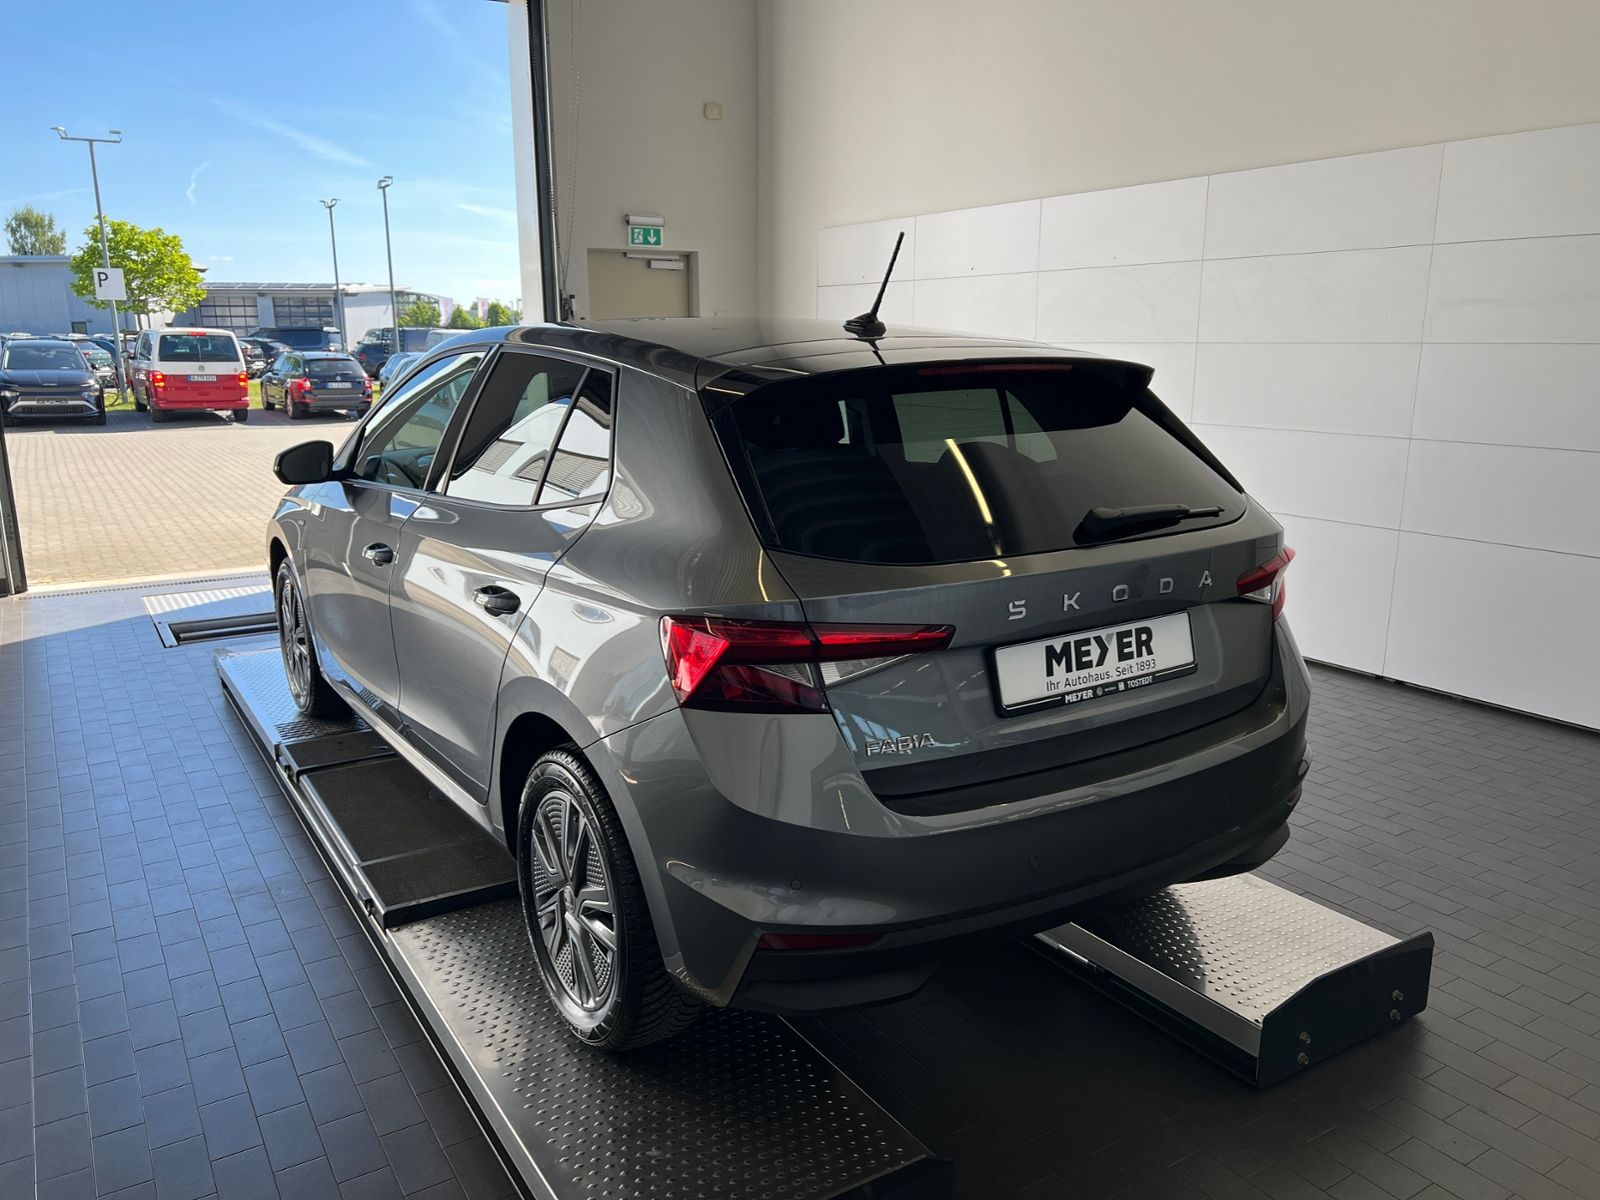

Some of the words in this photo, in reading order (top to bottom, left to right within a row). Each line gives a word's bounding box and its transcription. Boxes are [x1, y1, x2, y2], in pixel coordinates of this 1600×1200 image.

[97, 271, 109, 288] P
[1045, 626, 1154, 677] MEYER
[1046, 679, 1060, 692] Ihr
[1064, 671, 1113, 689] Autohaus.
[1115, 664, 1134, 677] Seit
[1136, 658, 1156, 673] 1893
[1065, 689, 1094, 704] MEYER
[1127, 675, 1153, 689] TOSTEDT
[866, 733, 936, 756] FABIA
